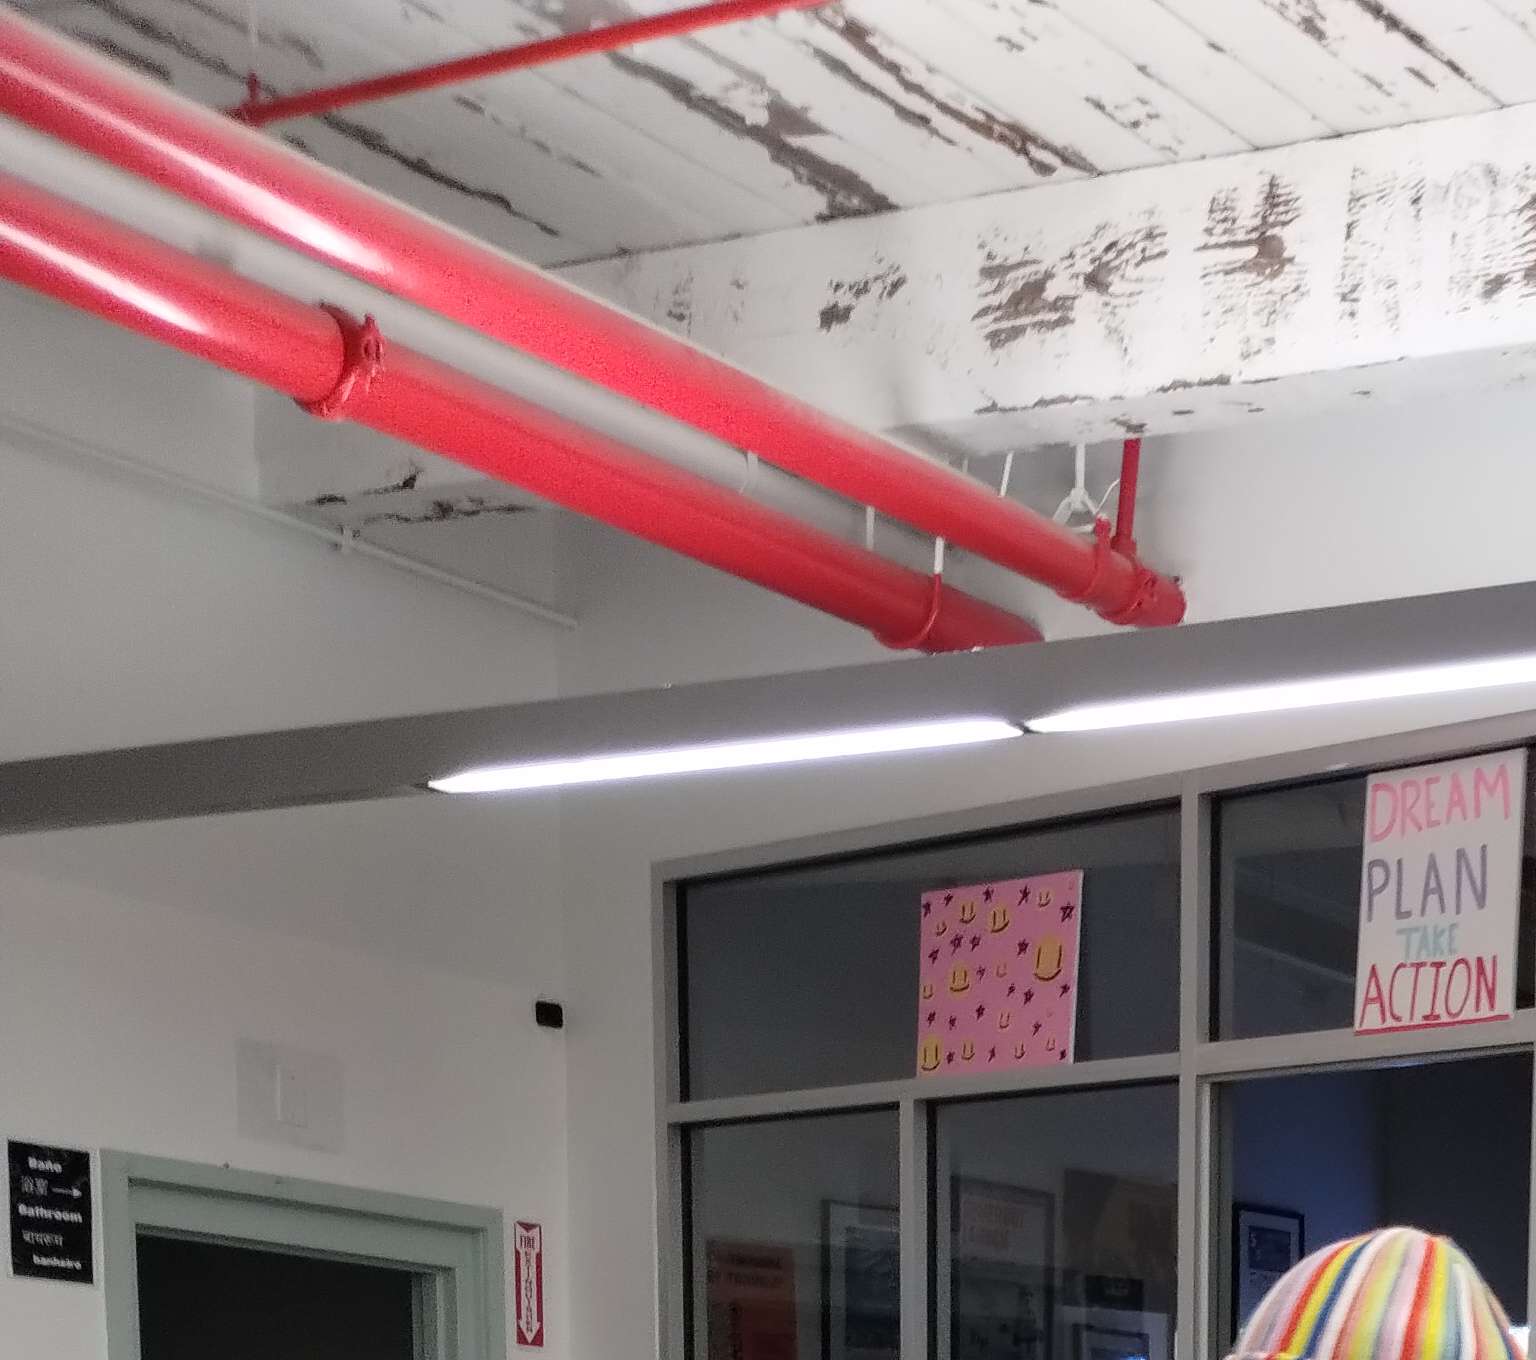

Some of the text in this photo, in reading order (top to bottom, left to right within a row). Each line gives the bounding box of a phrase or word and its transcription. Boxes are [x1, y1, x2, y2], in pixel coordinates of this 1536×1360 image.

[1368, 763, 1511, 842] DREAM
[1366, 843, 1488, 923] PLAN
[1396, 922, 1460, 960] TAKE
[1359, 955, 1498, 1028] ACTION
